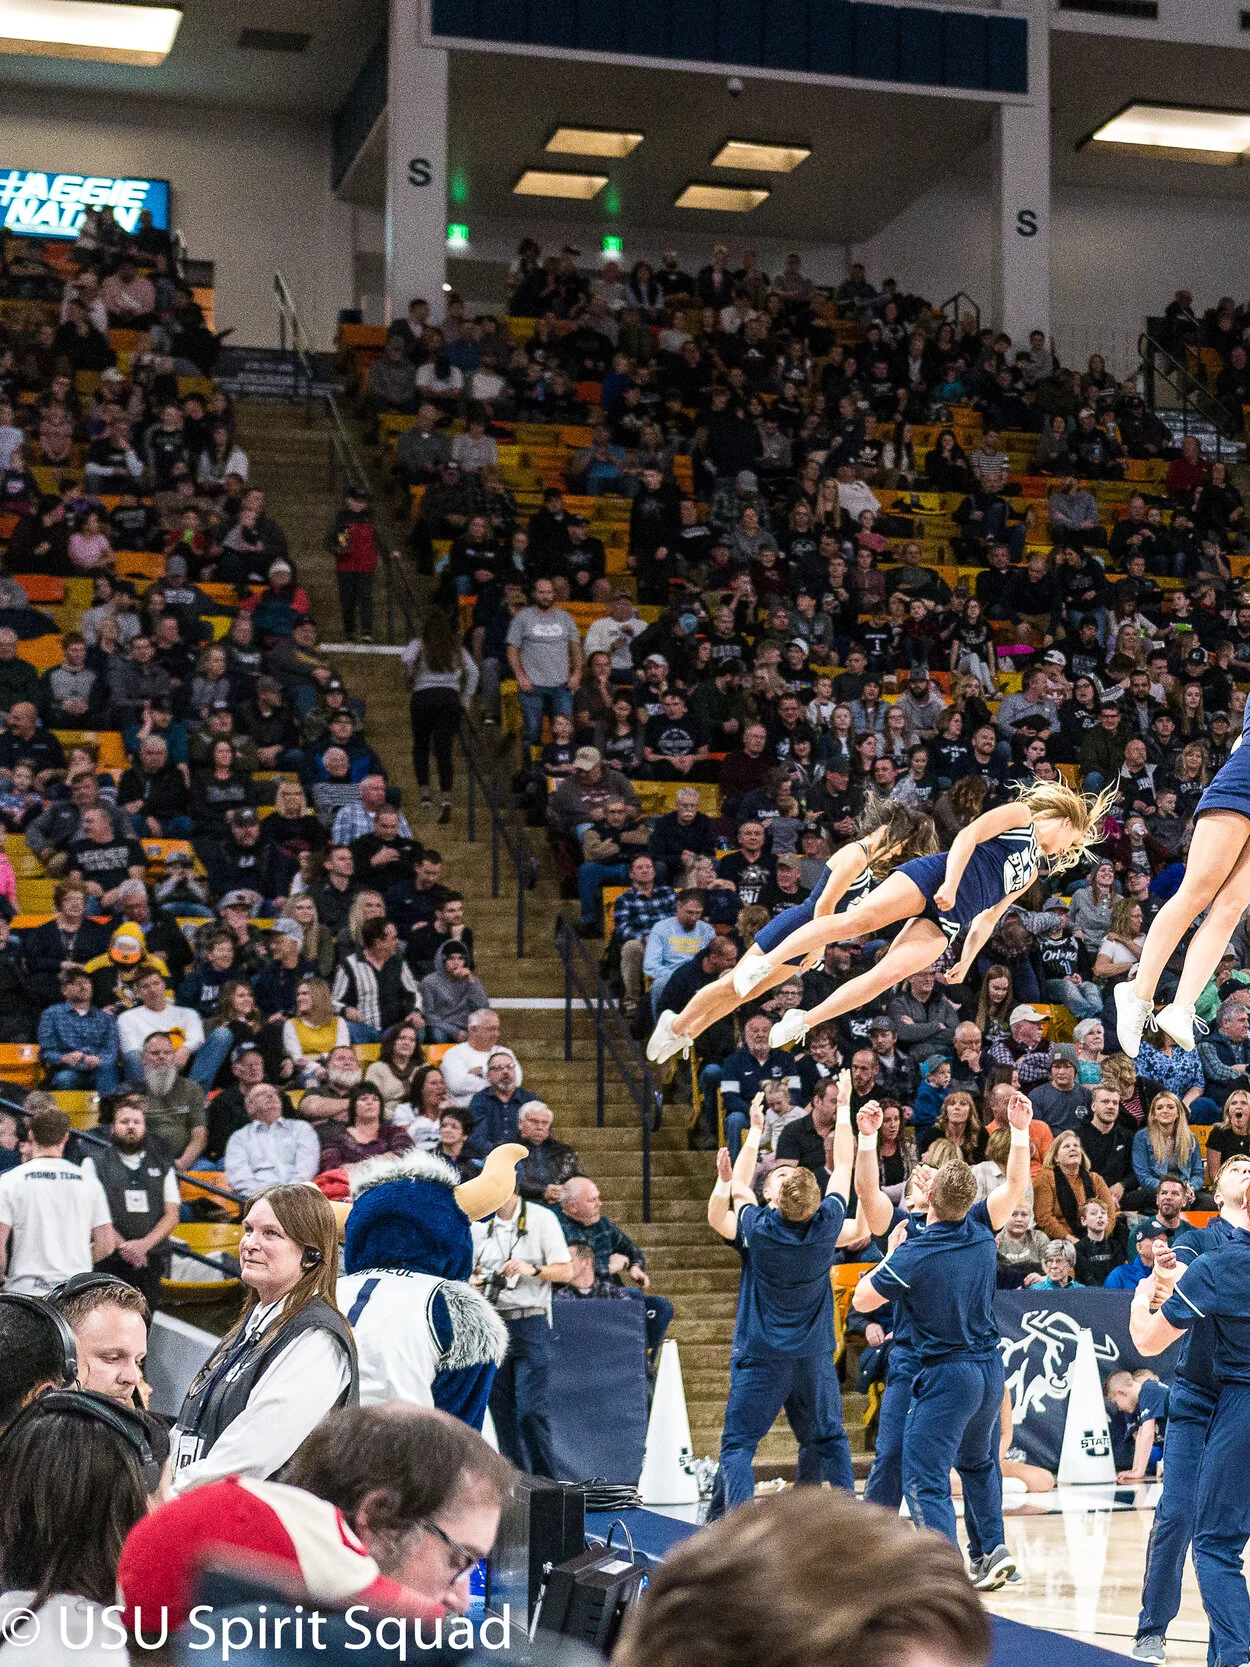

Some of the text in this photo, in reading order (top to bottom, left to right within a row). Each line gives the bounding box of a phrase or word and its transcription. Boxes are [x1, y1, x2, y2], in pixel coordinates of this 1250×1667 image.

[408, 158, 432, 187] S
[3, 199, 141, 235] NATN
[1016, 210, 1038, 237] S
